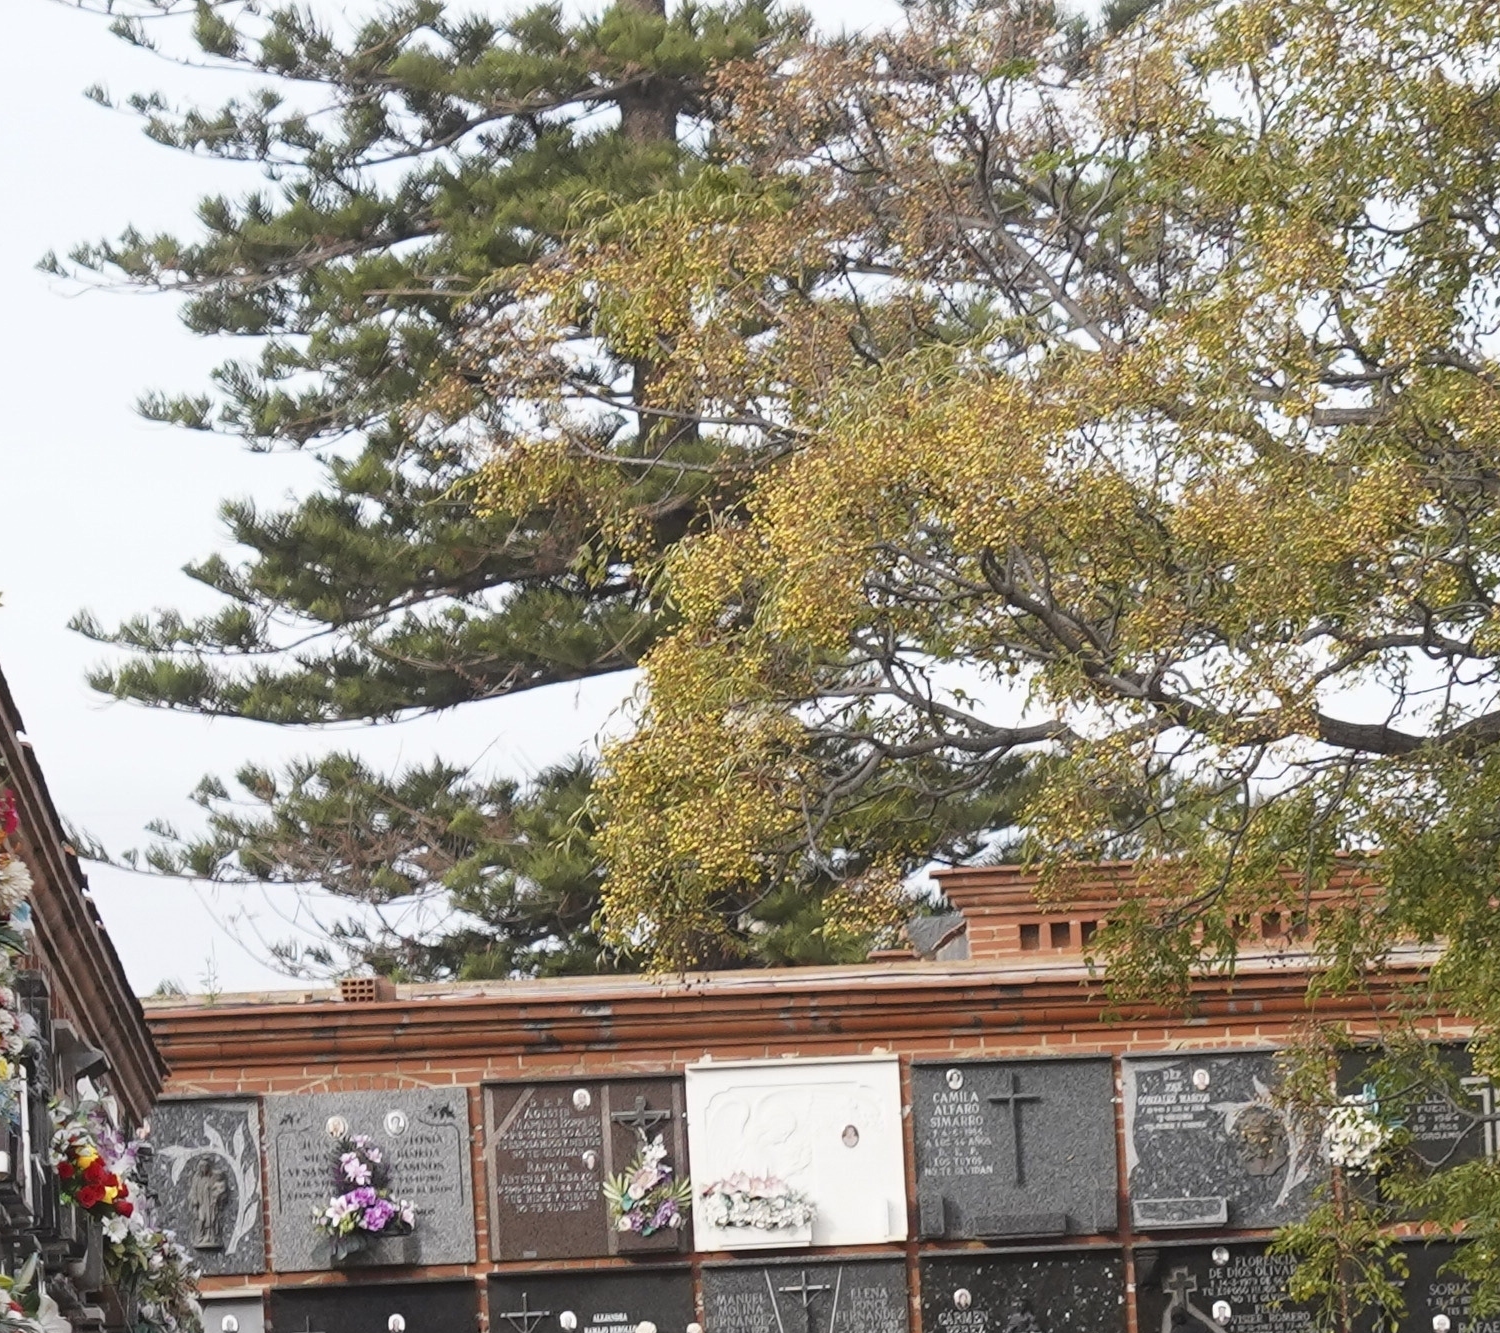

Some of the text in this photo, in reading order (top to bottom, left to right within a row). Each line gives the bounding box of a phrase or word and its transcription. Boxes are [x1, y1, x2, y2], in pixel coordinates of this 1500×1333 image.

[933, 1091, 979, 1104] CAMILA
[934, 1103, 980, 1116] ALFARO
[930, 1115, 984, 1128] SIMARRO
